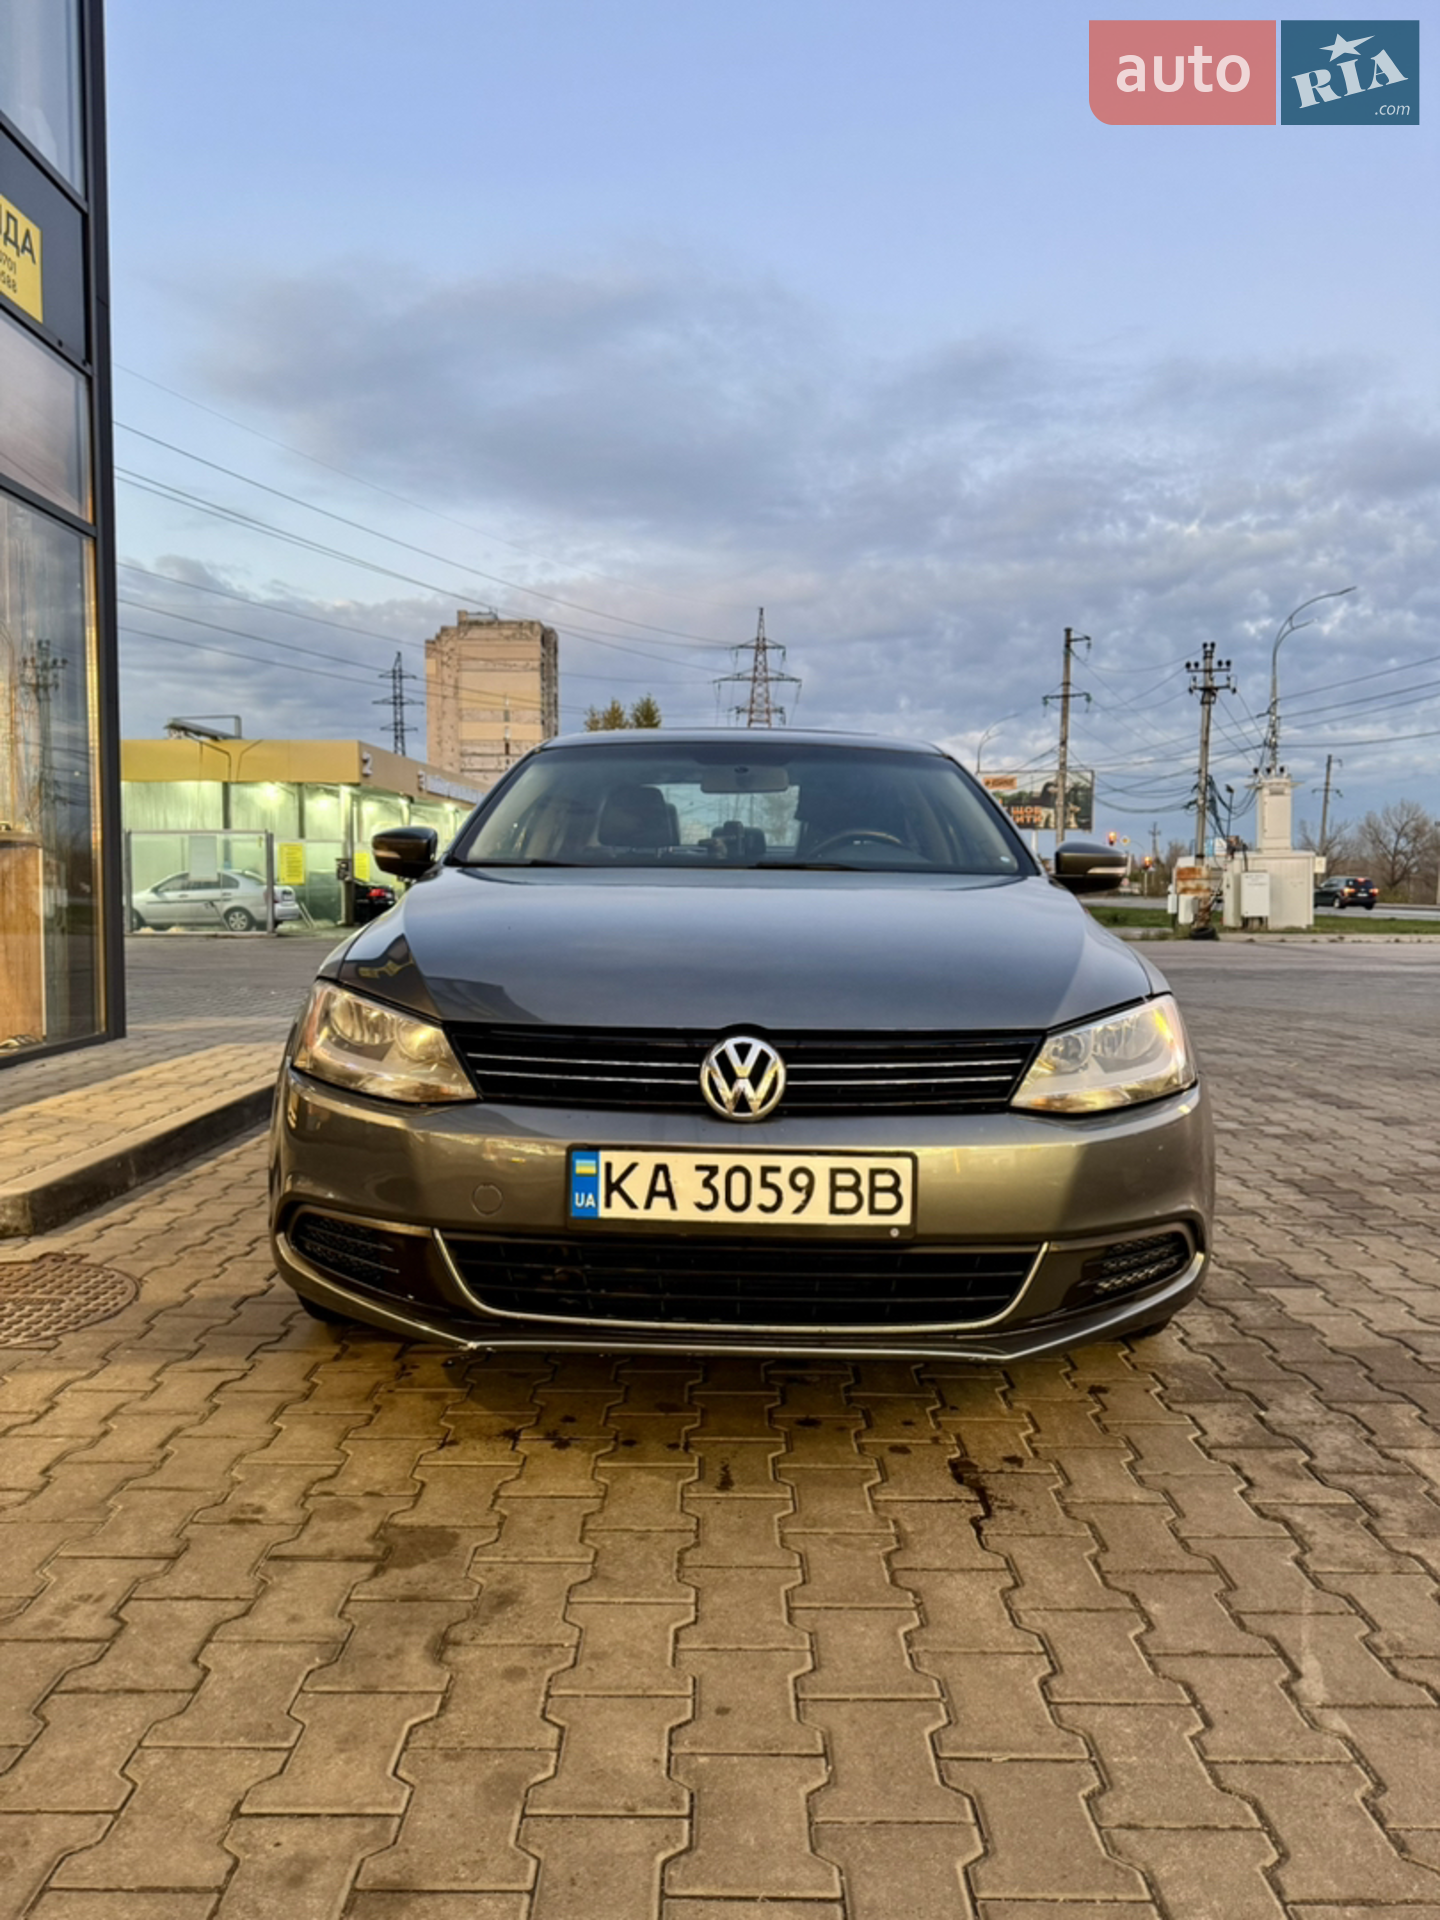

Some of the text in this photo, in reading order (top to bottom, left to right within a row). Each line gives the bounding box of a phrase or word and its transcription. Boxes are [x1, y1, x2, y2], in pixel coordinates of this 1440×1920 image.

[575, 1193, 596, 1208] UA
[604, 1161, 904, 1216] KA 3059 BB
